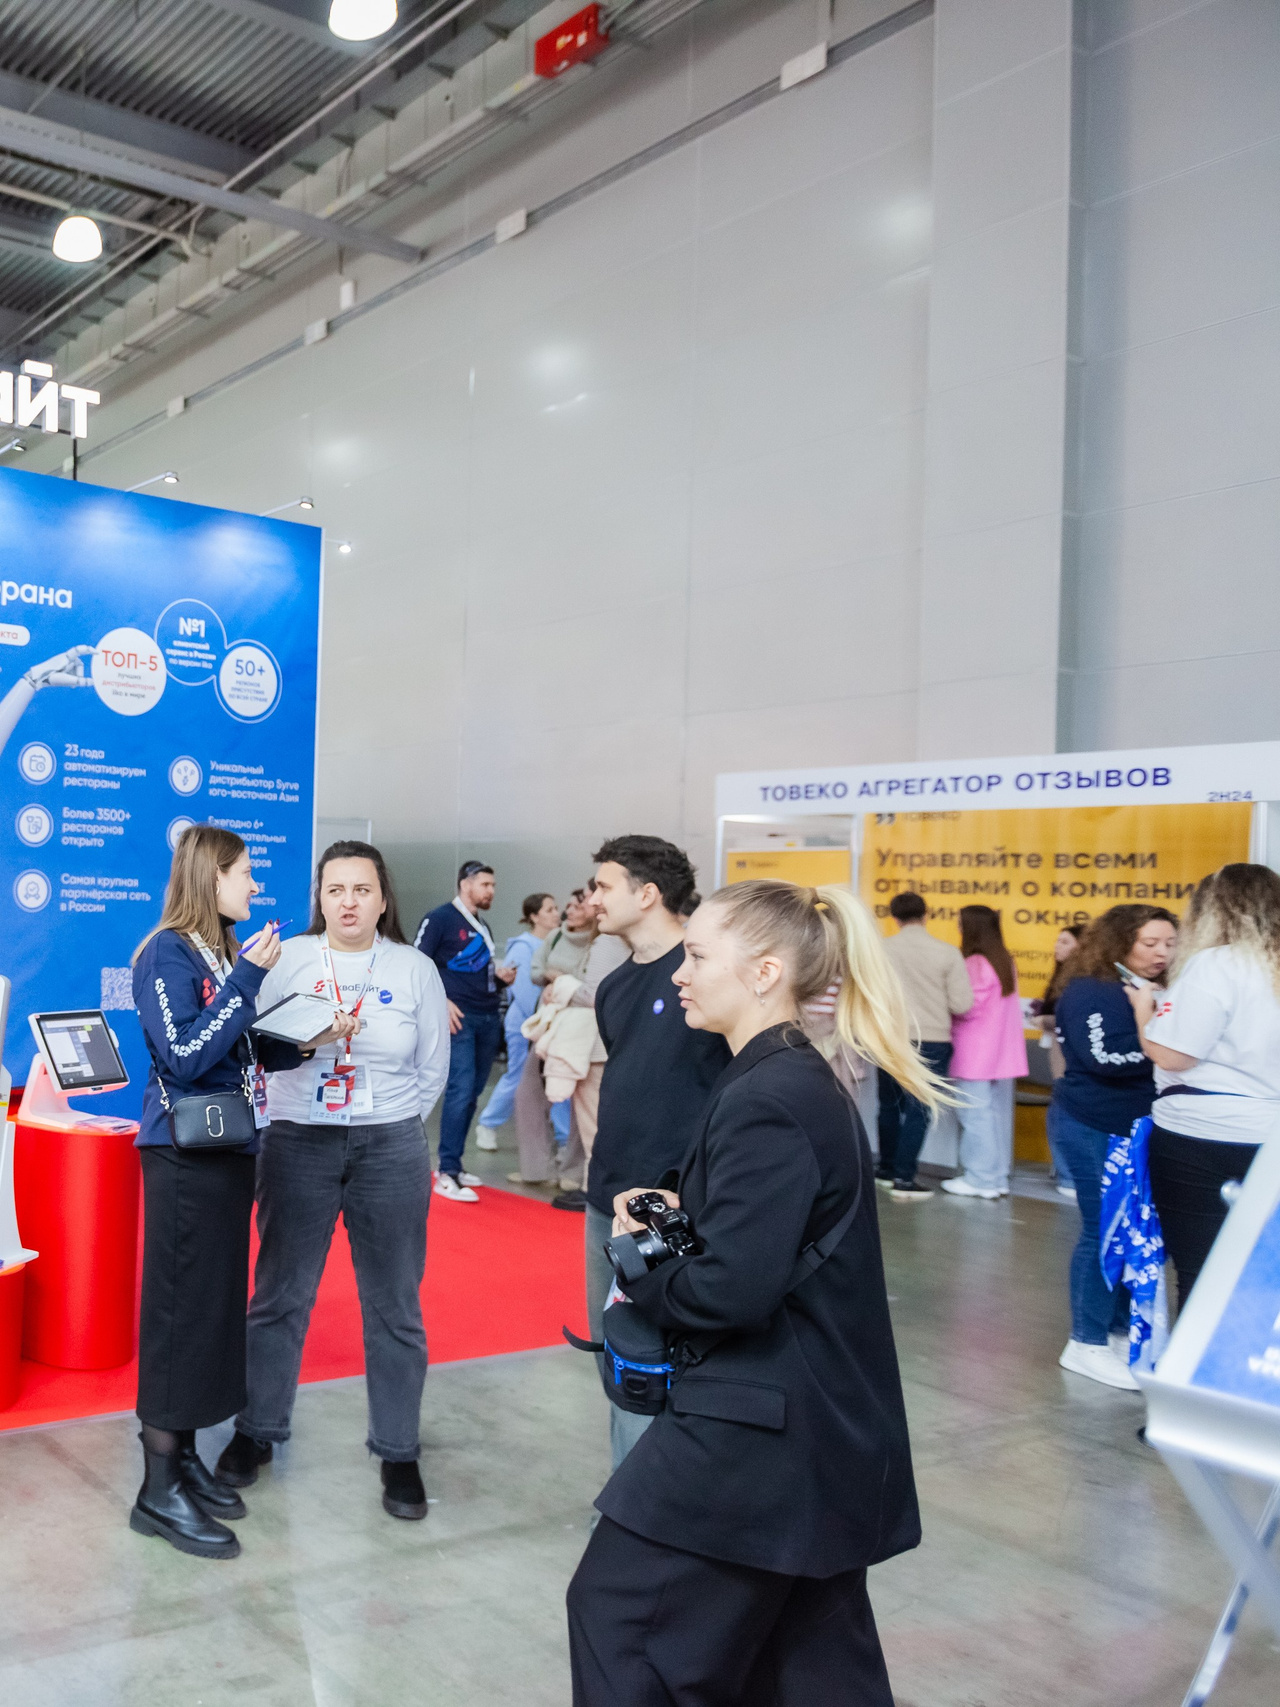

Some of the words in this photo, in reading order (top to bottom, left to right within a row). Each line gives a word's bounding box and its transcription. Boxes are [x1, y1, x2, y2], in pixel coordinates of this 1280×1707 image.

[178, 616, 206, 638] №1
[102, 650, 158, 671] ТОП-5
[235, 659, 265, 677] 50+
[64, 743, 79, 757] 23
[80, 748, 105, 760] года
[63, 762, 146, 778] автоматизируем
[209, 760, 264, 775] Уникальный
[63, 776, 120, 789] рестораны
[209, 775, 274, 790] дистрибьютор
[276, 778, 300, 791] Syrve
[759, 780, 849, 803] ТОВЕКО
[857, 775, 1002, 799] АГРЕГАТОР
[1015, 767, 1172, 791] ОТЗЫВОВ
[208, 787, 277, 801] юго-восточная
[279, 791, 300, 803] Азия
[62, 806, 95, 820] Более
[96, 807, 132, 822] 3500+
[62, 822, 124, 836] ресторанов
[253, 818, 264, 829] 6+
[61, 836, 105, 848] открыто
[251, 846, 268, 855] для
[876, 847, 1043, 872] Управляйте
[1054, 851, 1158, 869] всеми
[60, 872, 95, 885] Самая
[97, 876, 139, 888] крупная
[874, 878, 1010, 895] отзывами
[1022, 880, 1040, 897] о
[60, 888, 127, 901] партнёрская
[128, 892, 151, 901] сеть
[60, 902, 67, 911] в
[68, 900, 105, 912] России
[1014, 908, 1091, 925] окне
